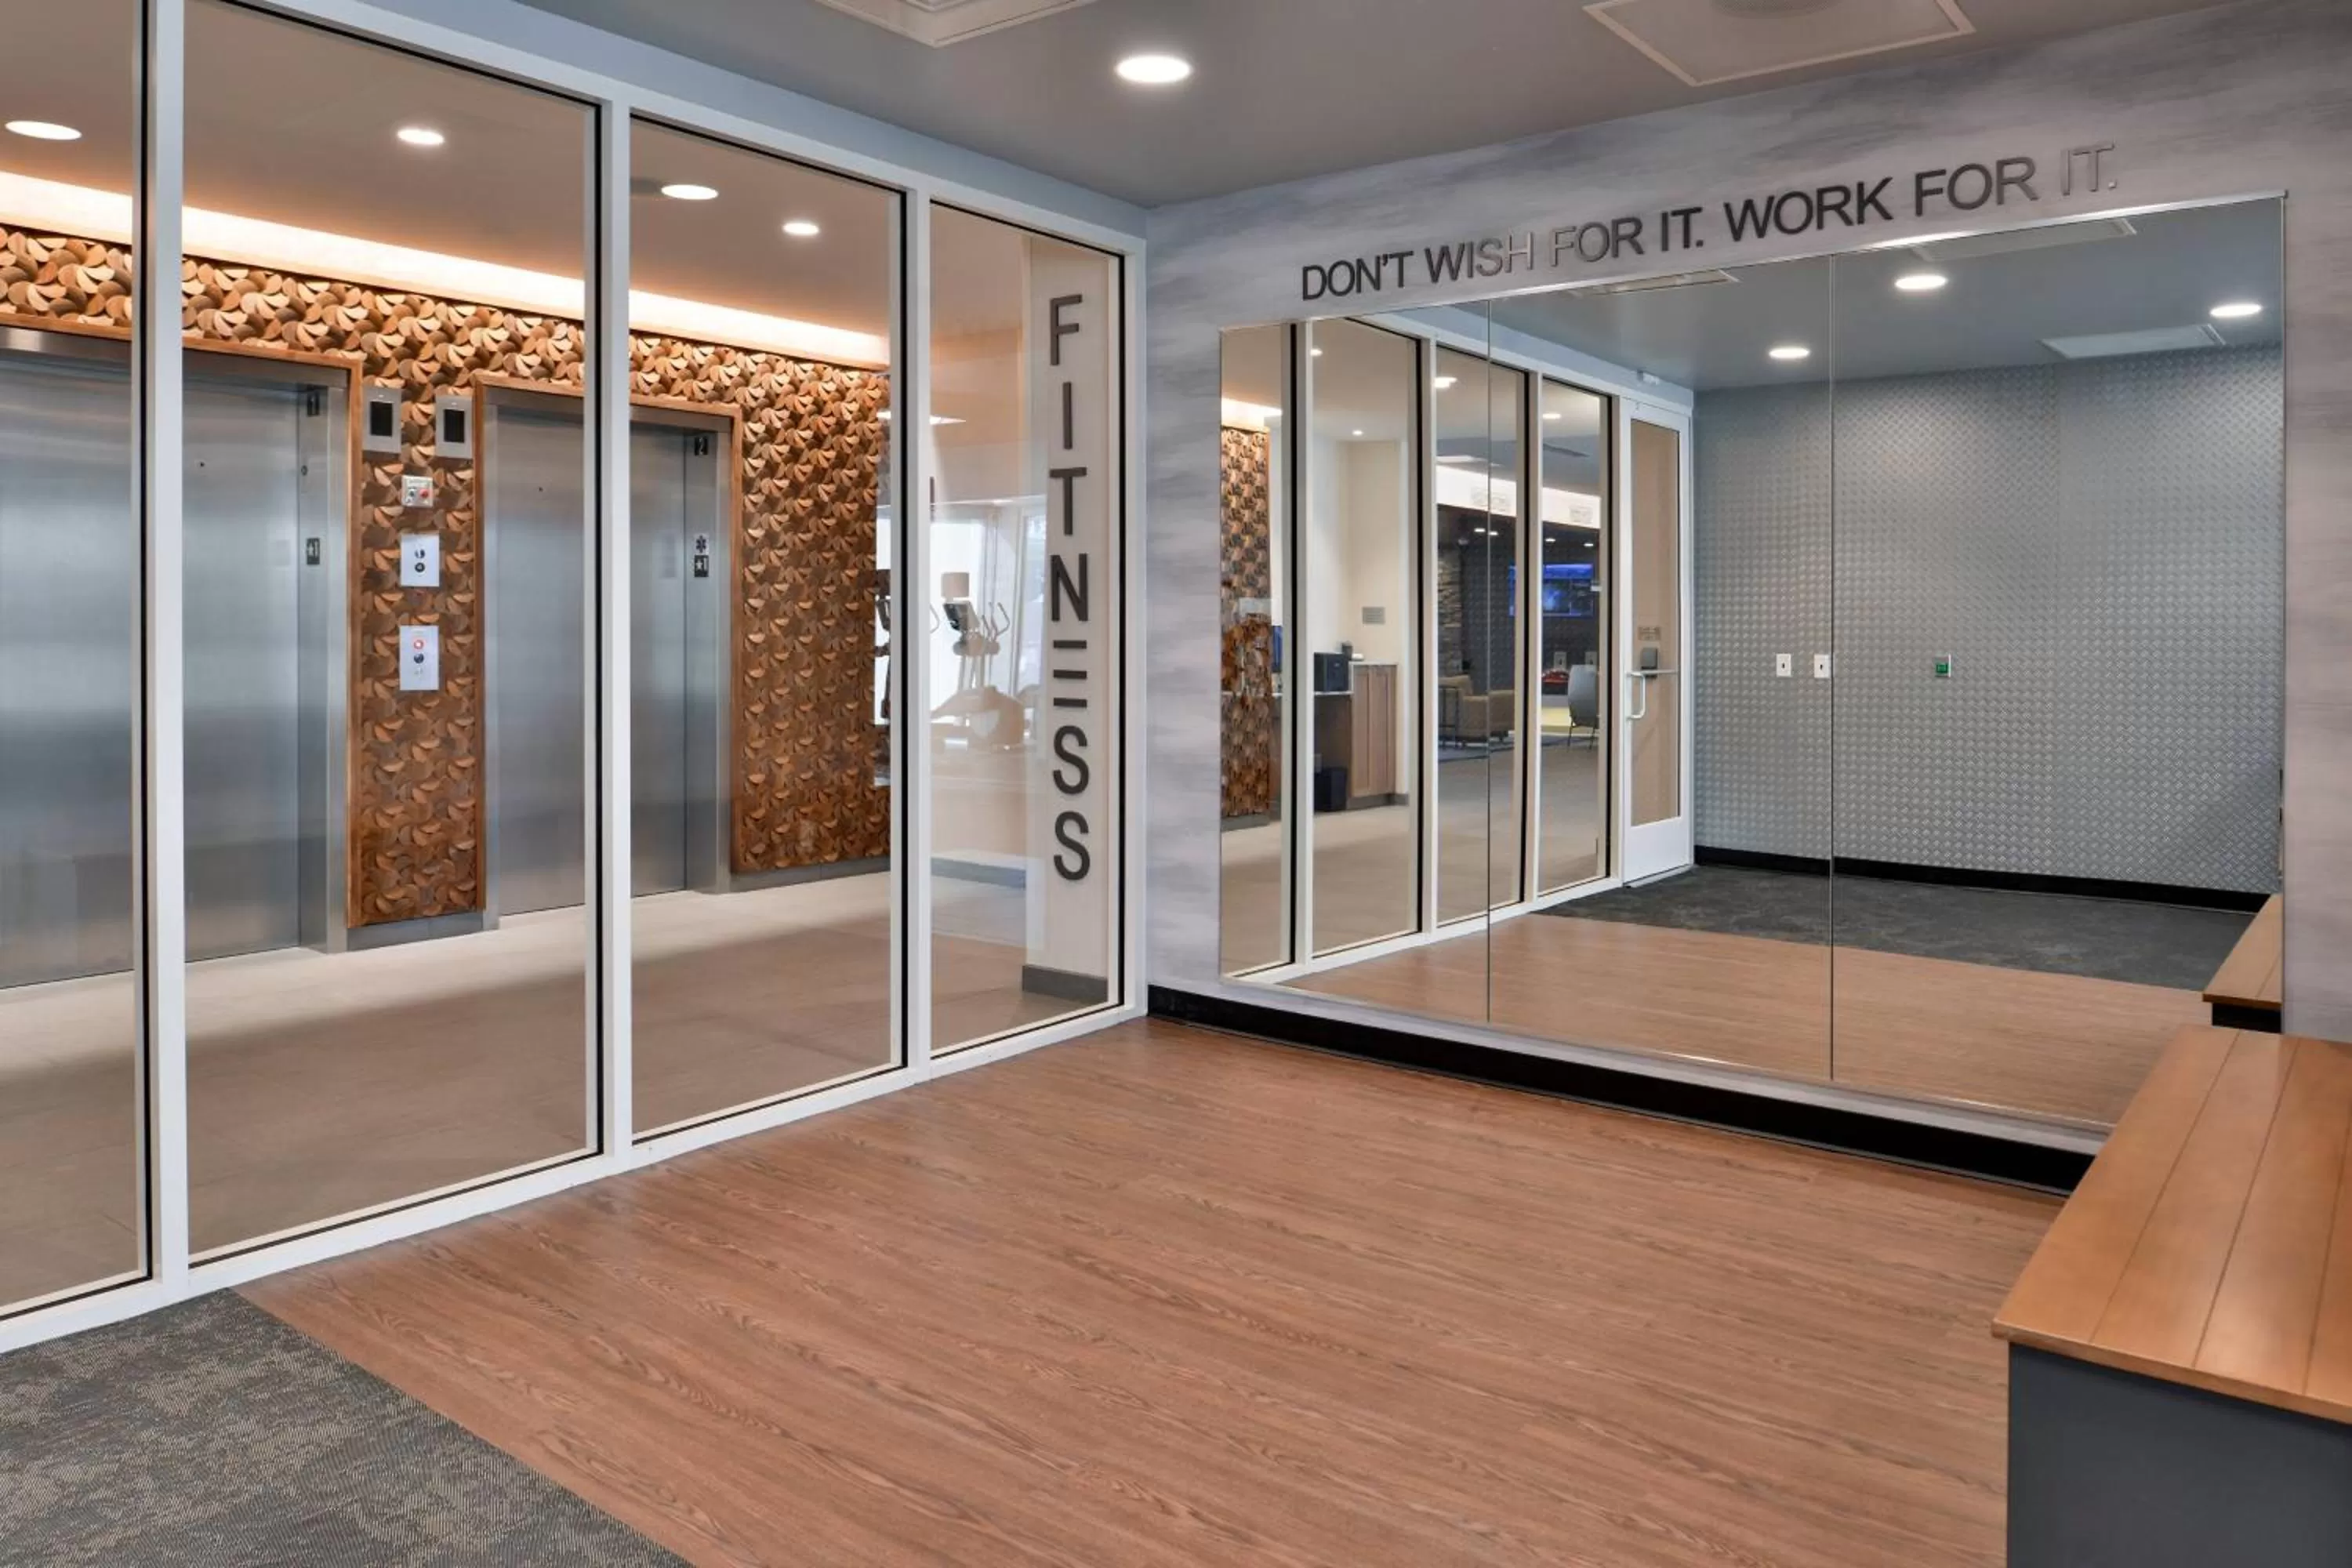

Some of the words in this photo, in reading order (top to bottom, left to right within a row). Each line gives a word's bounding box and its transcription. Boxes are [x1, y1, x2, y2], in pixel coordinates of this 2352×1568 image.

[1302, 251, 1414, 300] DON'T
[1424, 232, 1535, 284] WISH
[1550, 216, 1645, 267] FOR
[1661, 205, 1704, 252] IT.
[1724, 176, 1894, 241] WORK
[1914, 157, 2039, 217] FOR
[2060, 142, 2118, 196] IT.
[1049, 294, 1091, 881] FITNESS
